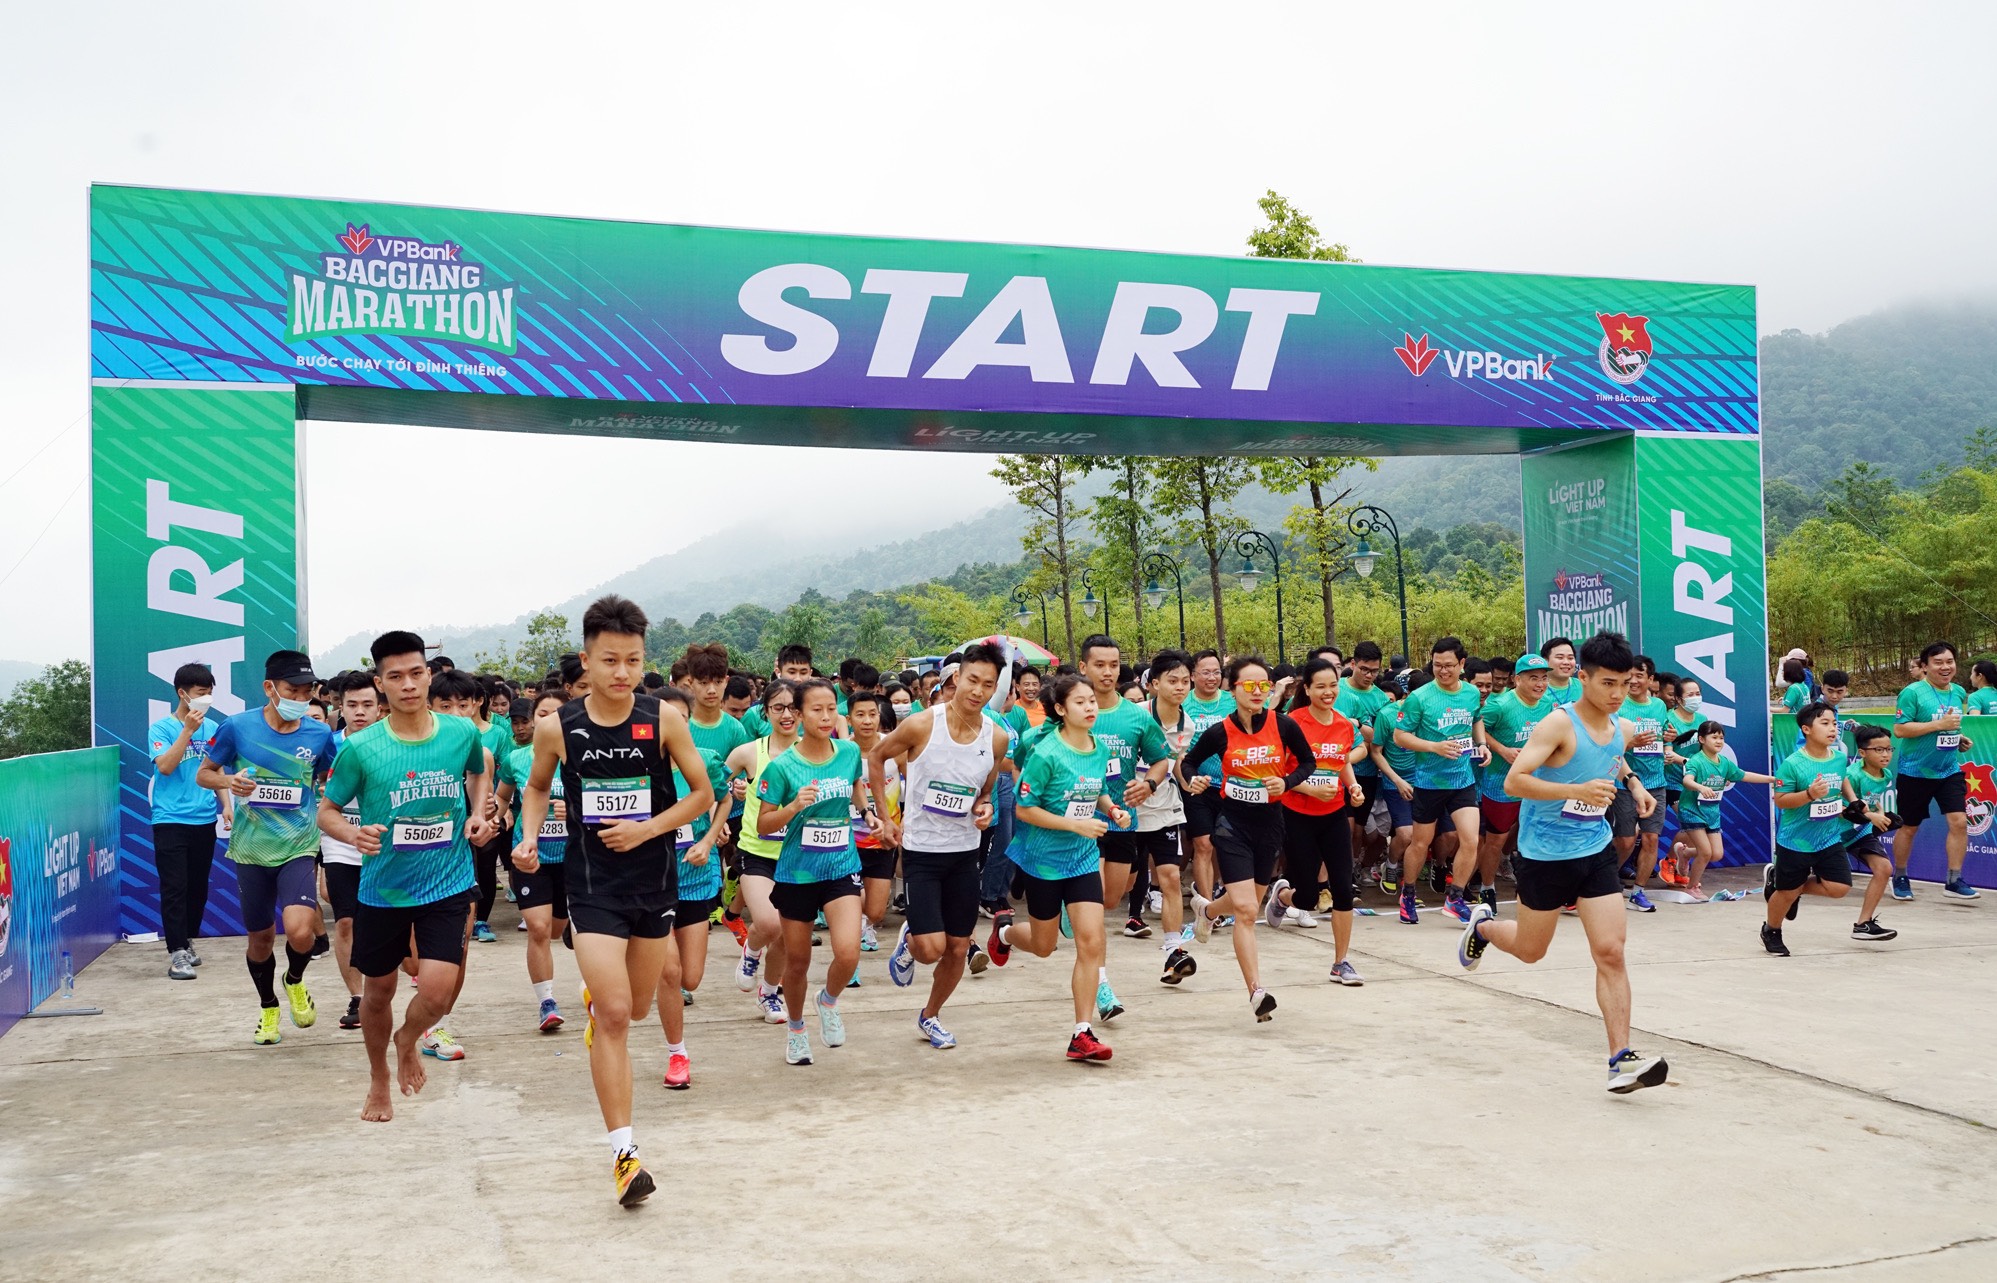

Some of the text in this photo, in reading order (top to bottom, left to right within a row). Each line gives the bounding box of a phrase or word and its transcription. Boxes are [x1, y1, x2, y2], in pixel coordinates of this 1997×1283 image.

[377, 238, 458, 262] VPBank
[326, 256, 480, 291] BACGIANG
[292, 274, 514, 348] MARATHON
[720, 262, 1321, 392] START
[296, 354, 338, 368] BƯỚC
[343, 358, 382, 373] CHẠY
[386, 358, 410, 372] TỚI
[456, 360, 507, 377] THIÊNG
[1443, 349, 1553, 381] VPBank
[1614, 392, 1630, 402] BẮC
[1632, 395, 1656, 403] GIANG
[1042, 432, 1097, 440] UP
[1588, 478, 1605, 498] UP
[1586, 496, 1606, 511] NAM
[1568, 574, 1602, 590] VPBank
[1550, 588, 1612, 612] BACGIANG
[1437, 716, 1473, 730] MARATHO
[582, 748, 644, 761] ANTA
[1247, 746, 1268, 759] 98
[1321, 743, 1338, 753] 98
[1232, 756, 1280, 767] Runners
[258, 788, 292, 800] 55616
[389, 781, 460, 809] MARATHON
[934, 793, 964, 809] 55171
[1232, 788, 1260, 801] 55123
[597, 795, 637, 811] 55172
[1818, 803, 1837, 815] 55410
[404, 826, 444, 841] 55062
[813, 830, 842, 844] 55127
[69, 831, 80, 868] UP
